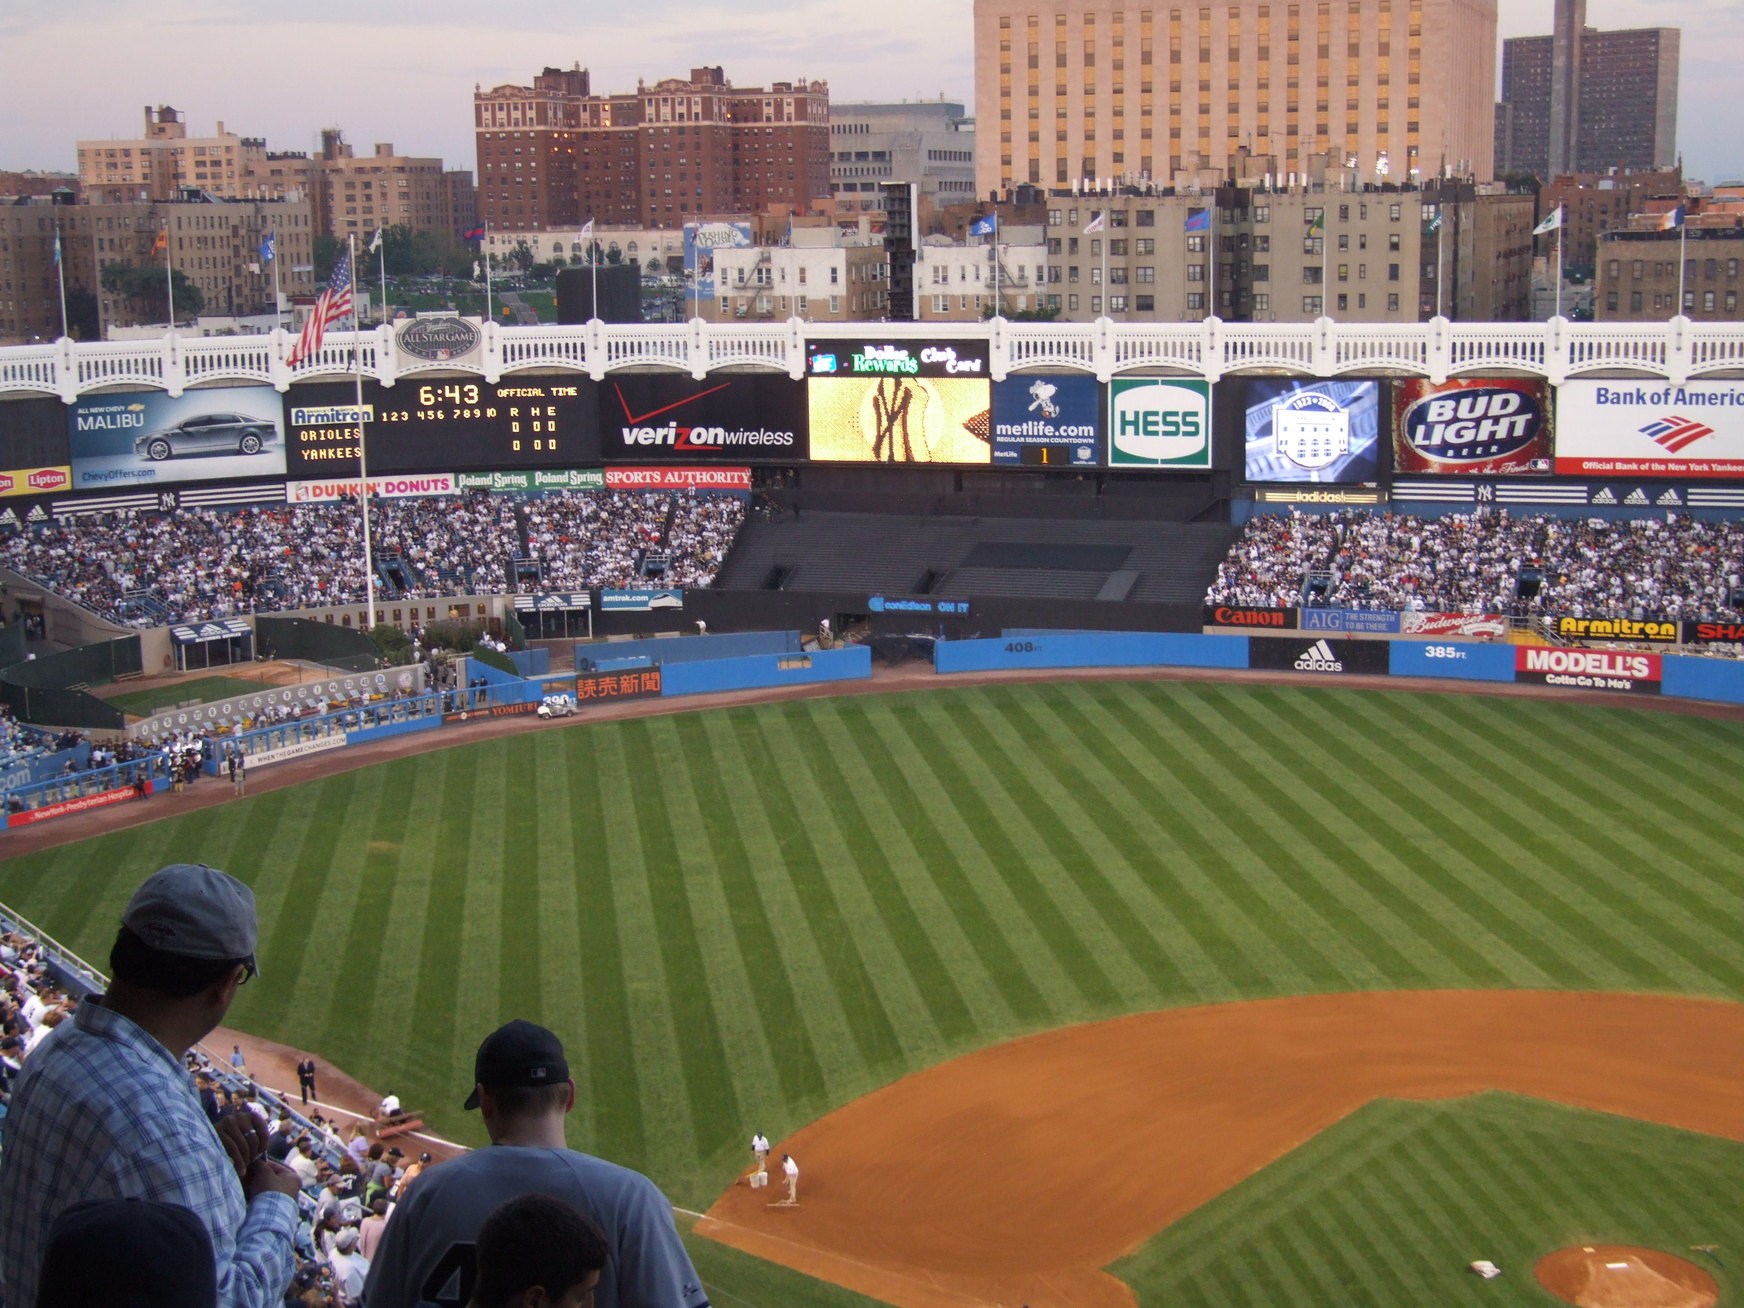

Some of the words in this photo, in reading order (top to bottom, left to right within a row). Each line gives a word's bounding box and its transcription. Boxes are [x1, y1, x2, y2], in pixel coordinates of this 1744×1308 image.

[420, 384, 479, 406] 6:43
[497, 388, 545, 397] OFFICIAL
[551, 387, 577, 396] TIME
[1596, 387, 1646, 405] Bank
[1650, 387, 1671, 405] of
[1674, 388, 1744, 406] Americ
[510, 407, 519, 417] R
[531, 407, 540, 417] H
[547, 406, 556, 416] E
[1427, 392, 1520, 424] BUD
[77, 413, 144, 431] MALIBU
[295, 408, 371, 424] Armitron
[1120, 410, 1199, 436] HESS
[512, 421, 520, 432] 0
[533, 421, 541, 432] 0
[548, 420, 556, 432] 0
[996, 421, 1094, 436] metlife.com
[1414, 413, 1532, 447] LIGHT
[300, 429, 361, 441] ORIOLES
[513, 440, 520, 451] 0
[534, 440, 542, 450] 0
[549, 439, 557, 450] 0
[302, 447, 362, 460] YANKEES
[1041, 448, 1048, 464] 1
[1583, 462, 1613, 470] Official
[1615, 462, 1638, 470] Bank
[1640, 463, 1649, 471] of
[1651, 463, 1666, 471] the
[1668, 463, 1687, 471] New
[30, 474, 64, 487] Lipton
[82, 469, 156, 481] ChevyOffers.com
[459, 474, 492, 487] Poland
[494, 473, 527, 487] Spring
[535, 471, 568, 485] Poland
[570, 471, 603, 485] Spring
[606, 472, 661, 484] SPORTS
[664, 471, 751, 484] AUTHORITY
[385, 478, 450, 494] DONUTS
[1215, 607, 1284, 626] Canon
[1308, 612, 1340, 628] AIG
[1345, 613, 1357, 621] THE
[1359, 613, 1395, 622] STRENGTH
[1406, 614, 1486, 633] Budweiser
[1560, 617, 1676, 635] Armitron
[1004, 641, 1034, 653] 408
[1294, 658, 1342, 672] adidas
[1526, 650, 1649, 677] MODELL'S
[577, 672, 661, 699] 読売新聞
[1546, 674, 1576, 685] Gotta
[1577, 675, 1591, 687] Go
[1593, 677, 1607, 688] To
[1608, 678, 1631, 690] Mo's
[107, 787, 135, 802] Hospital
